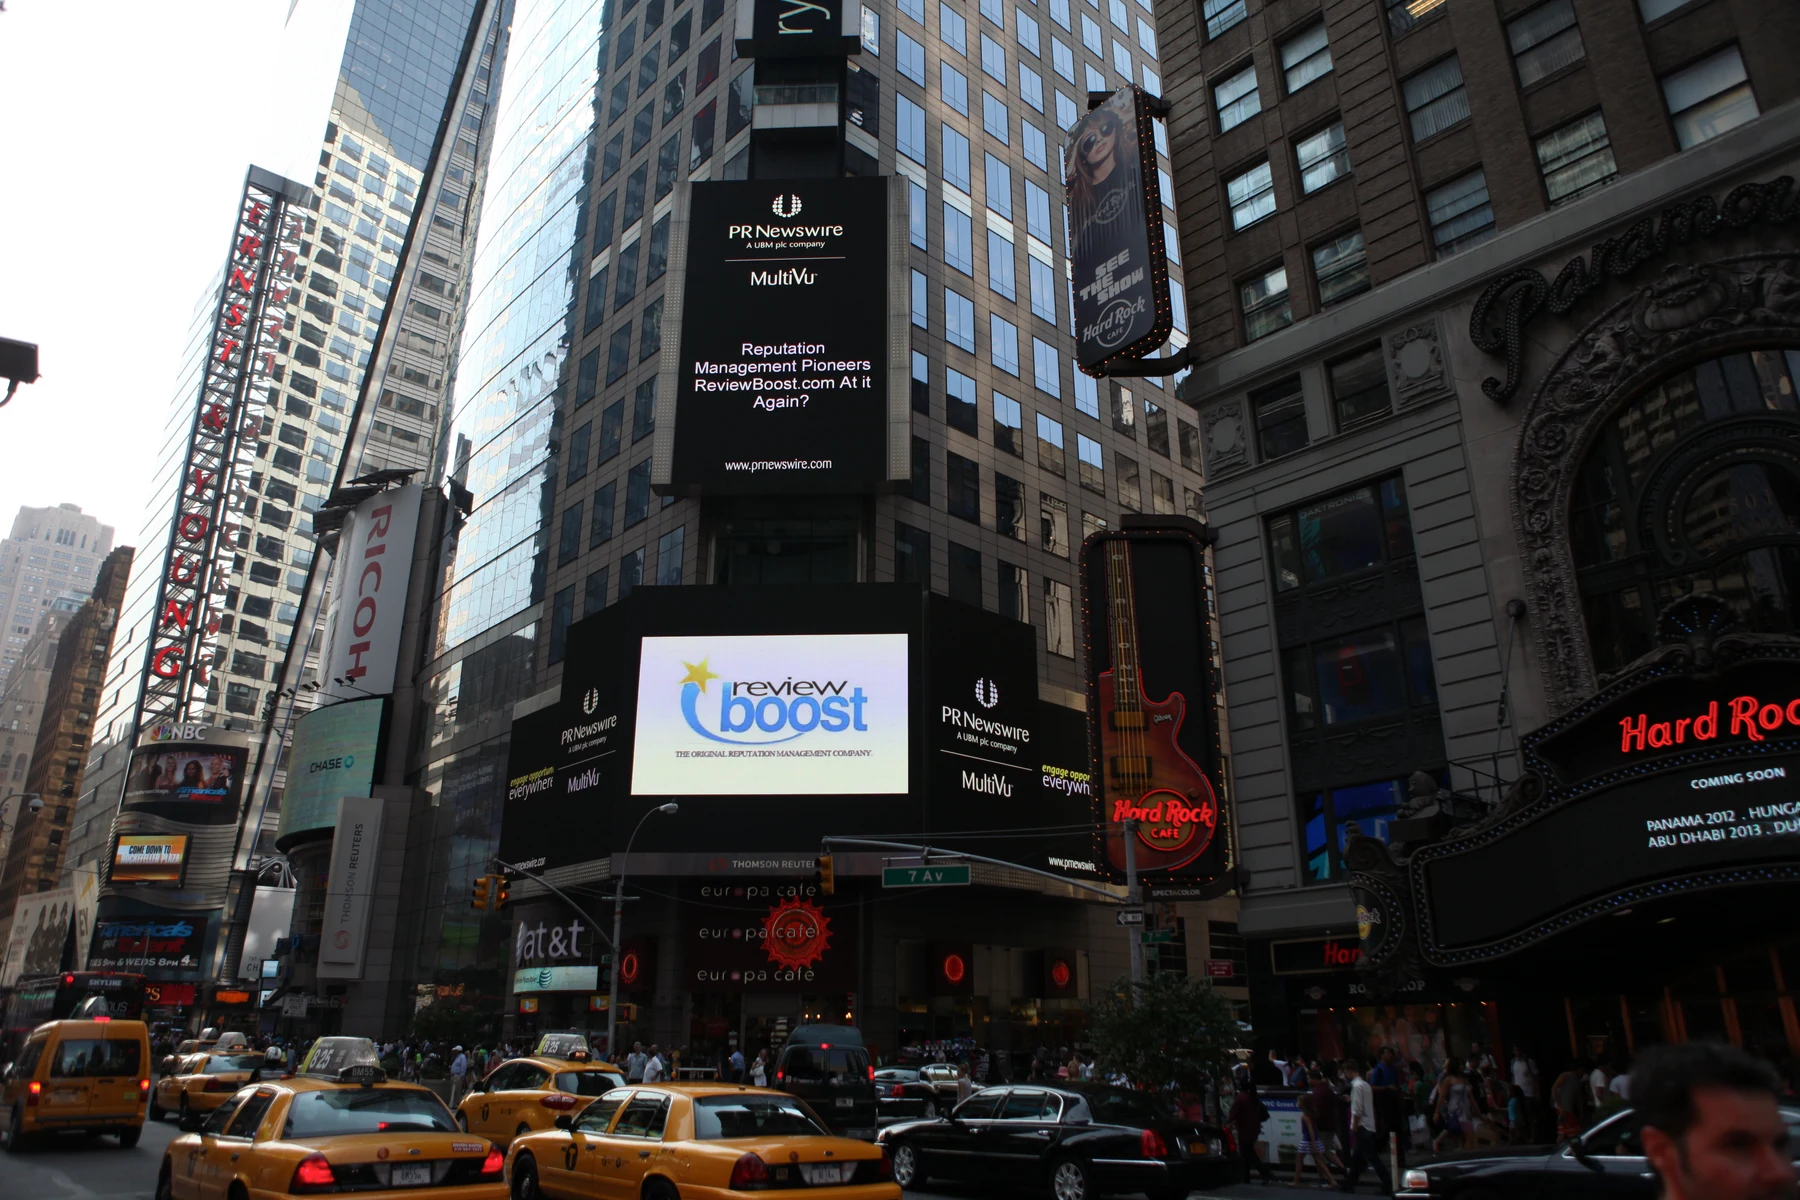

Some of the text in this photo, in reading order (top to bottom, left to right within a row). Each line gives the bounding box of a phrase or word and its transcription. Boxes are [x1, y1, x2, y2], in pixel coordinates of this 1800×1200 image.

[729, 225, 843, 239] PR Newswire
[775, 241, 787, 249] plc
[789, 241, 826, 249] company
[1095, 248, 1130, 280] SEE
[219, 202, 267, 362] ERNST
[1079, 271, 1114, 301] THE
[1097, 265, 1144, 306] SHOW
[1083, 295, 1145, 343] Hard Rock
[742, 342, 825, 358] Reputation
[694, 359, 871, 376] Management Pioneers
[694, 376, 872, 391] ReviewBoost.com At it
[753, 394, 810, 412] Again?
[153, 468, 215, 678] YOUNG
[346, 504, 392, 679] RICOH
[732, 677, 848, 696] review
[720, 682, 868, 733] boost
[171, 725, 207, 740] NBC
[561, 715, 617, 745] PR Newswire
[942, 706, 1030, 742] PR Newswire
[1619, 701, 1718, 752] Hard
[957, 732, 1018, 755] A UBM plc company
[310, 757, 342, 773] CHASE
[1042, 764, 1069, 778] engage
[1690, 767, 1786, 789] COMING SOON
[1113, 799, 1214, 828] Hard Rock
[1647, 814, 1704, 831] PANAMA
[1705, 810, 1736, 824] 2012
[1150, 828, 1180, 839] CAFE
[1648, 834, 1677, 848] ABU
[1680, 829, 1726, 844] DHABI
[1728, 824, 1762, 838] 2013
[129, 846, 146, 854] COME
[164, 846, 172, 854] TO
[340, 823, 364, 924] THOMSON REUTERS
[732, 860, 779, 869] THOMSON
[908, 870, 943, 882] 7 Av
[524, 919, 585, 960] at&t
[1323, 942, 1364, 966] Har
